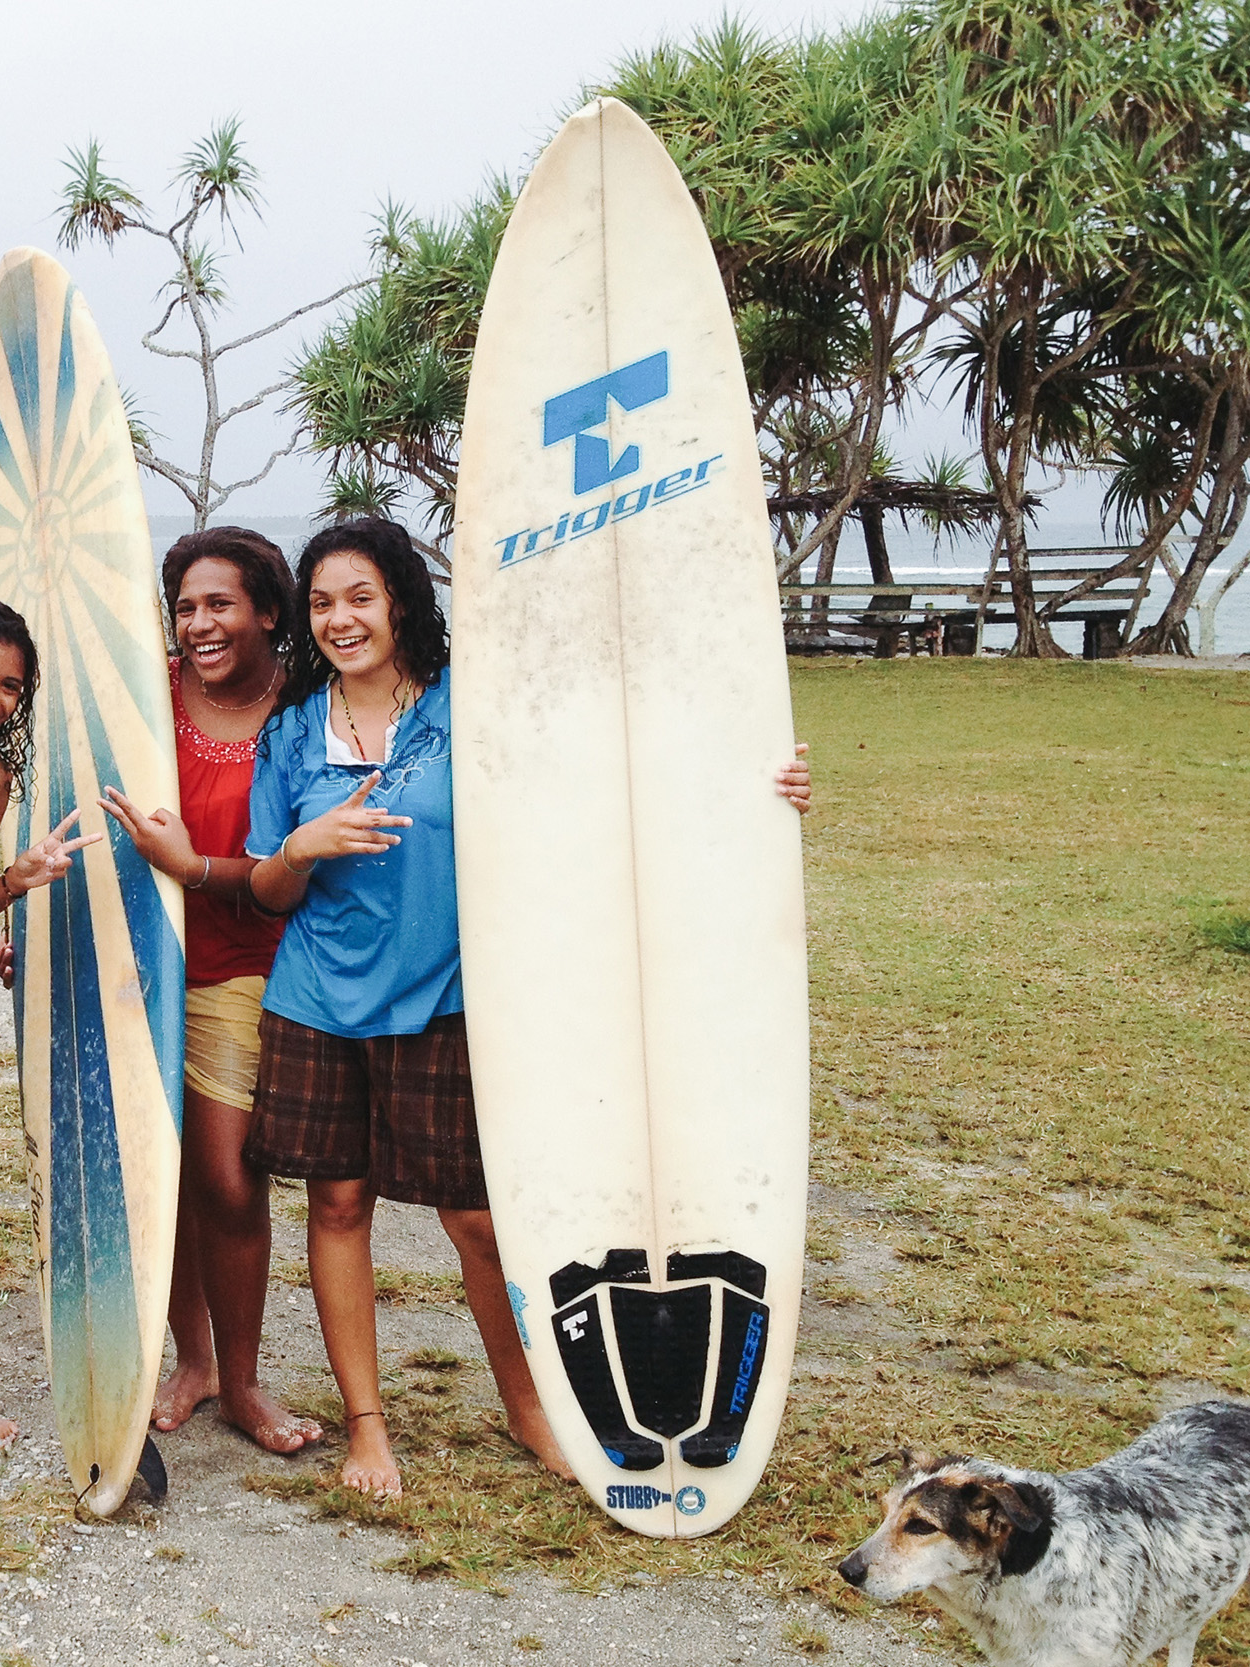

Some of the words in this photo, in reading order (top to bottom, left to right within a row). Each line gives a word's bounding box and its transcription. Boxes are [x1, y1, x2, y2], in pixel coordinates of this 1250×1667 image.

[495, 454, 723, 570] Trigger
[729, 1311, 764, 1414] TRIGGER
[606, 1484, 661, 1510] STUBBY
